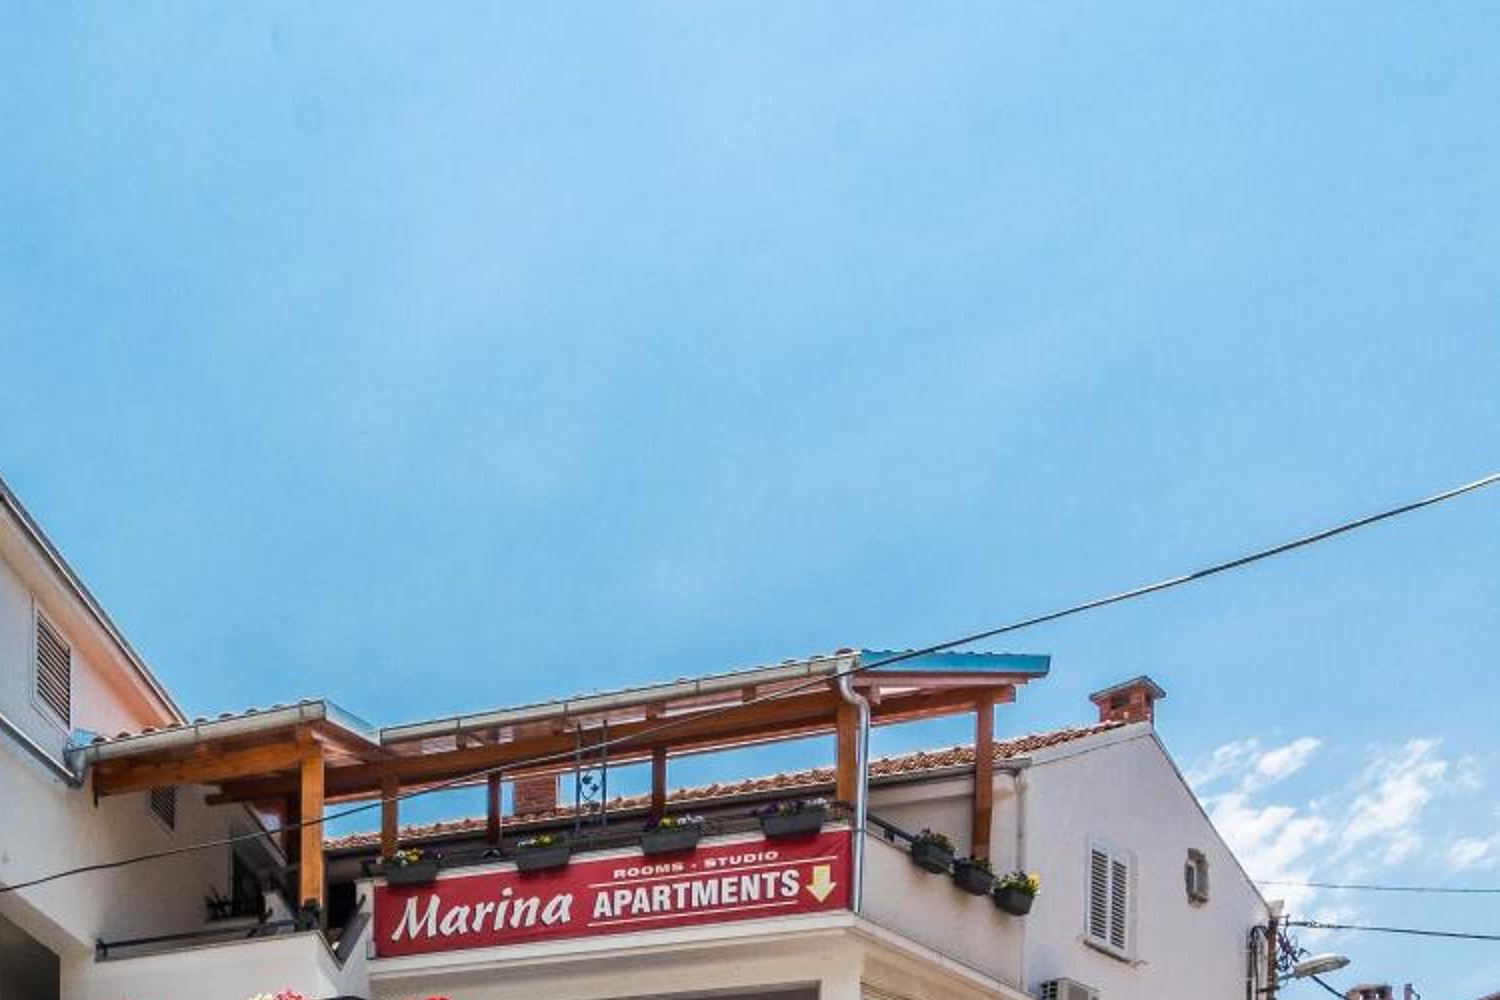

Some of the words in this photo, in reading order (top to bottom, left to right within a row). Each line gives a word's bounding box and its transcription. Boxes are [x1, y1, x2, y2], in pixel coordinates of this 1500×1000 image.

[613, 861, 685, 879] ROOMS
[703, 851, 780, 868] STUDIO
[391, 887, 573, 942] Marina
[593, 869, 800, 918] APARTMENTS
